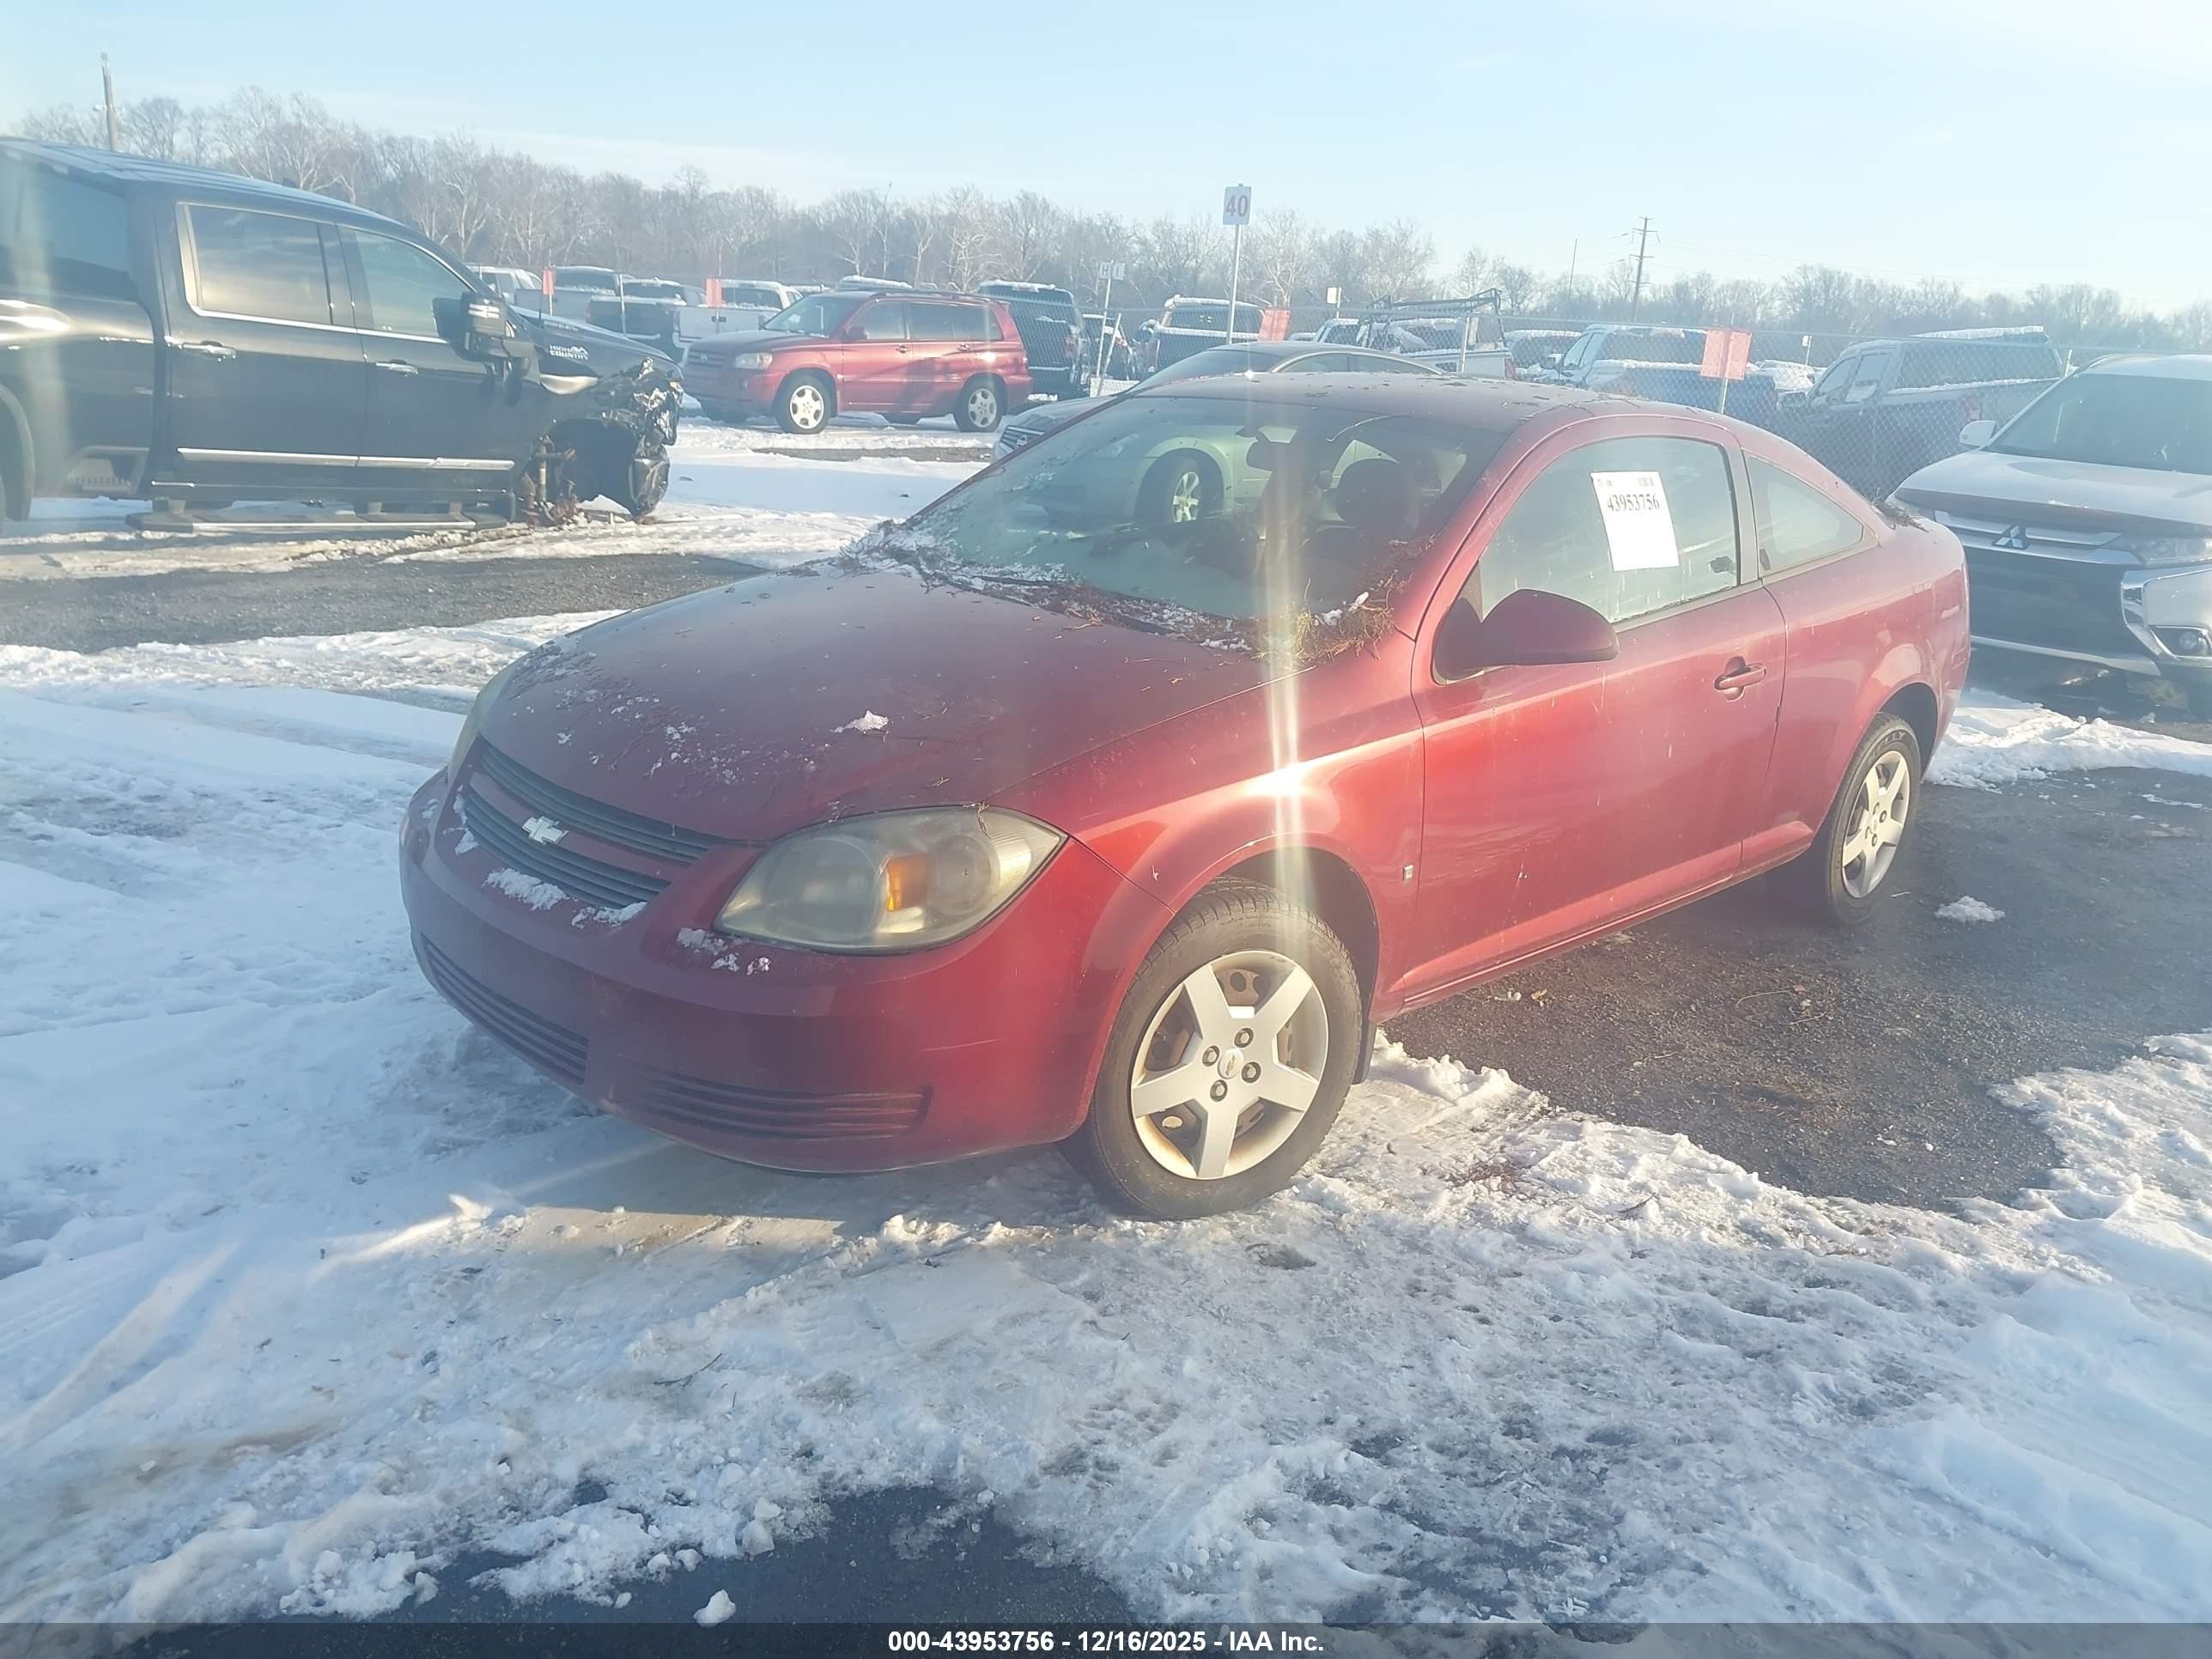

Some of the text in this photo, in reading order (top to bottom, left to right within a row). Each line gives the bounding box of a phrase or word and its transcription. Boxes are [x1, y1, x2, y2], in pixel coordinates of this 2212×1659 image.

[1225, 195, 1249, 217] 40
[550, 349, 589, 361] COUNTRY
[1607, 493, 1661, 512] 43953756
